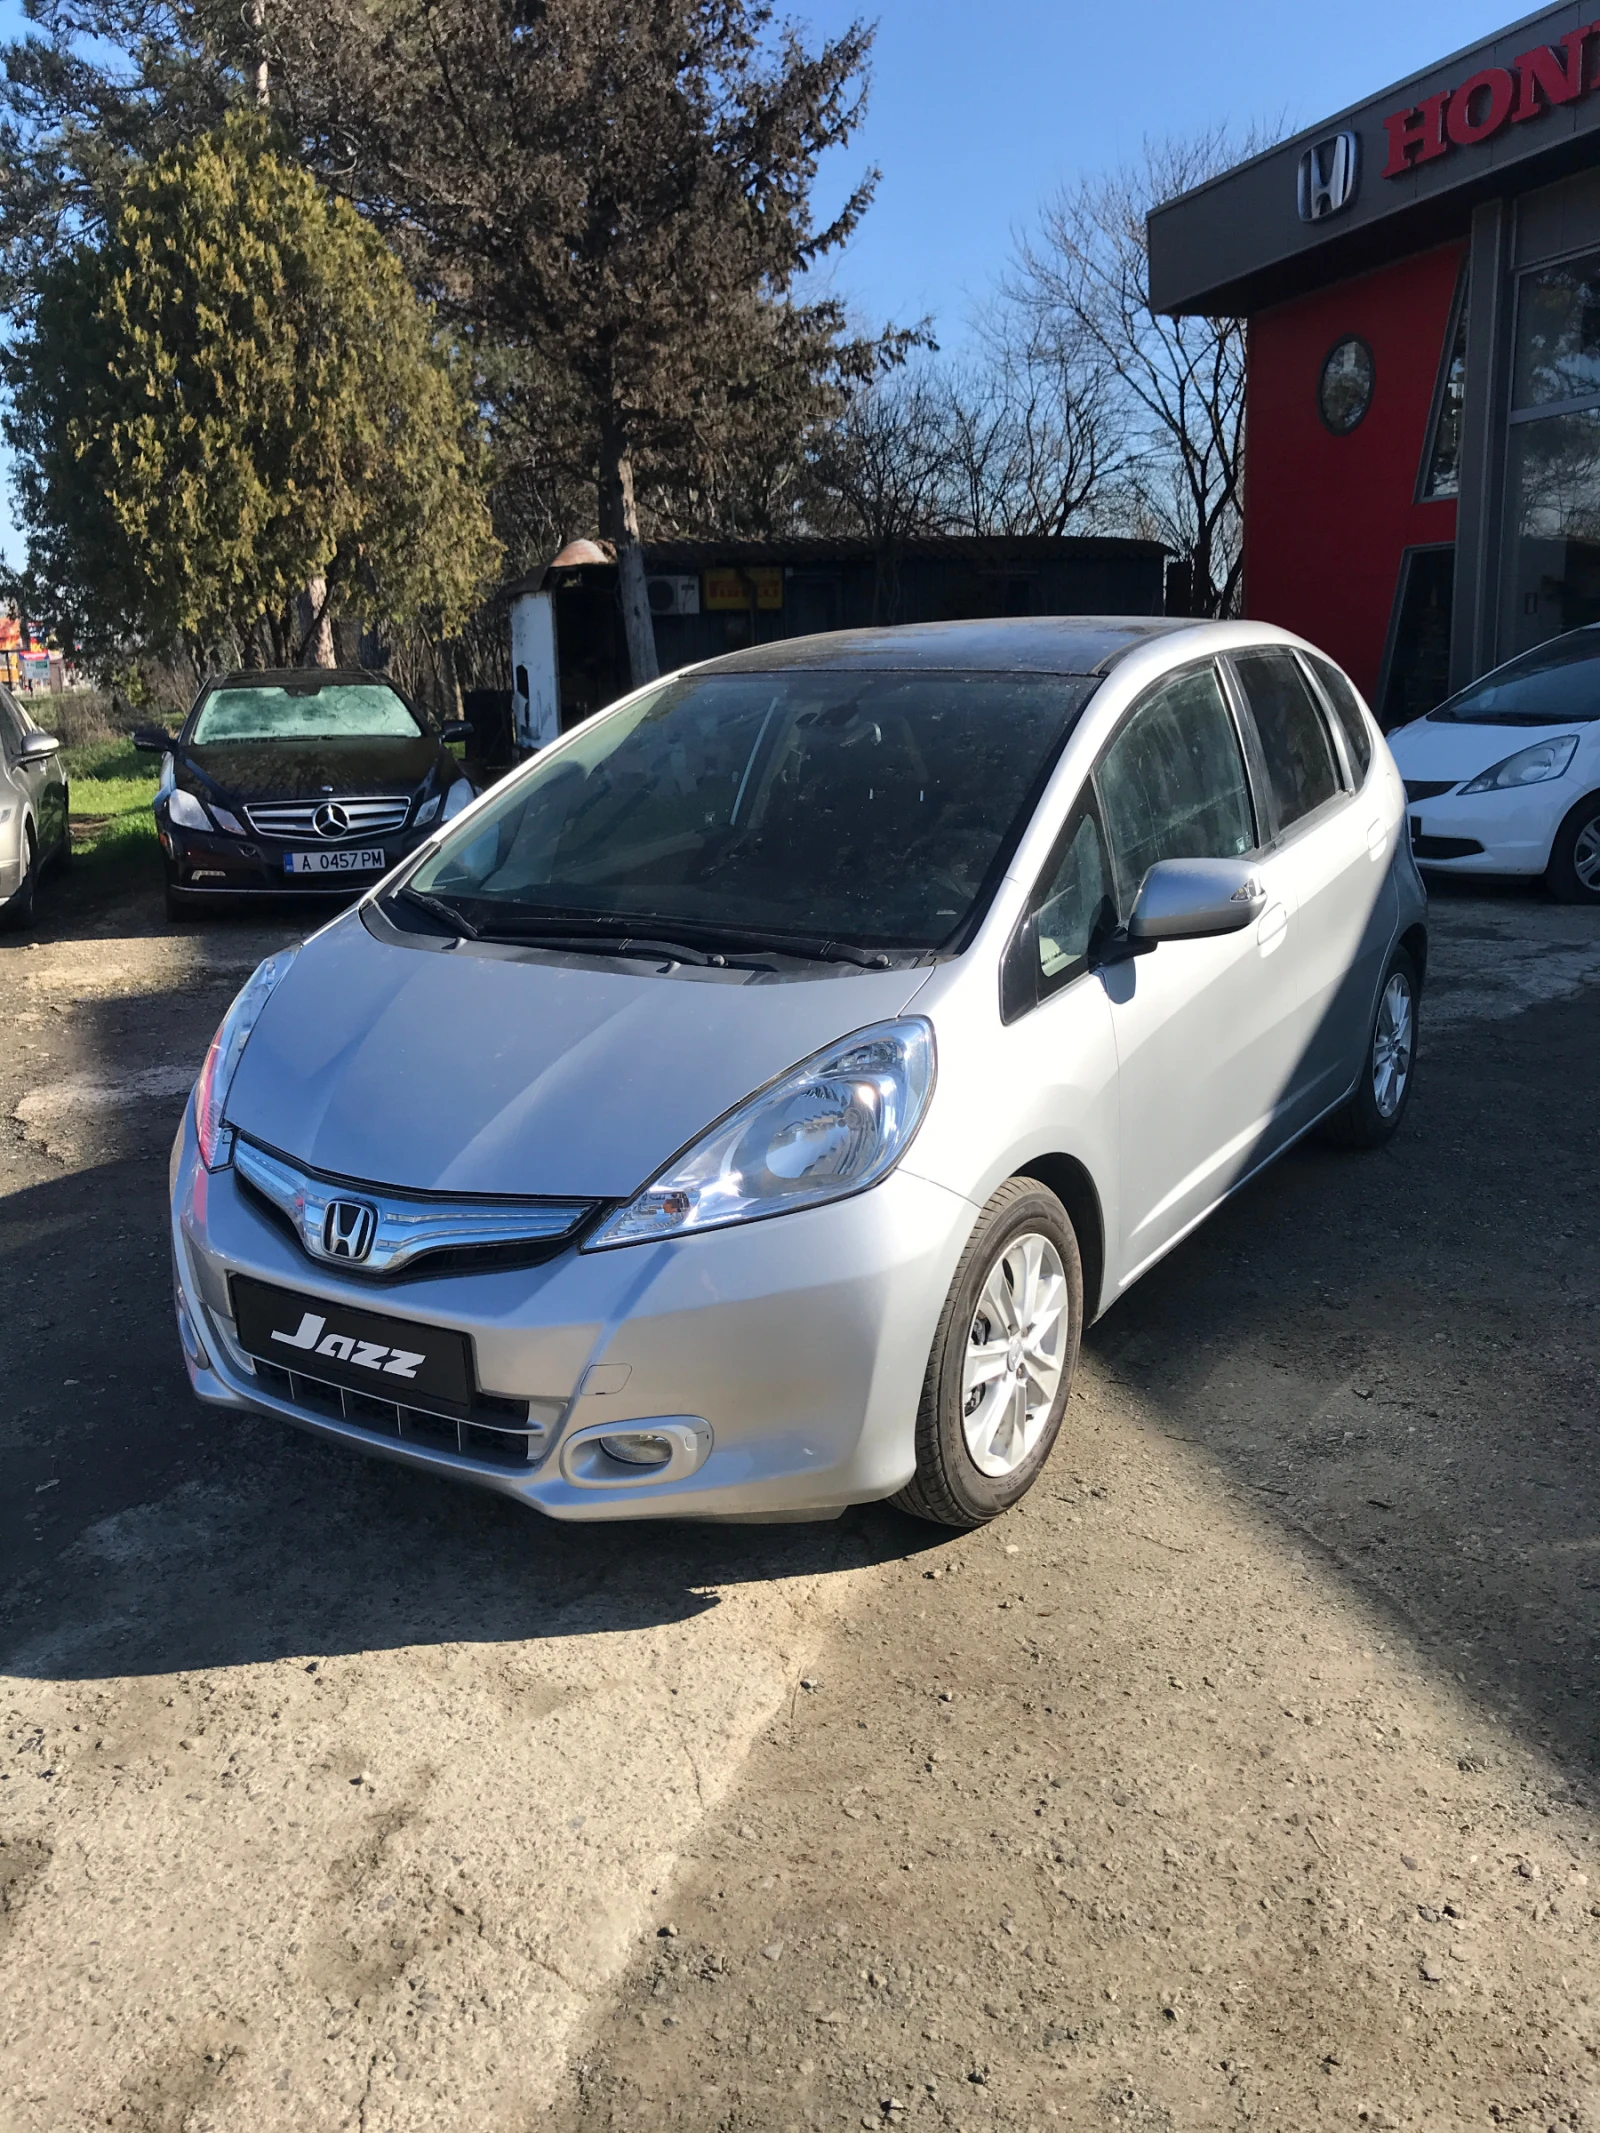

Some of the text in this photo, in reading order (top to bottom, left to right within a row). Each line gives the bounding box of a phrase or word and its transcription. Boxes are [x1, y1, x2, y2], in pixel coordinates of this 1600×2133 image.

[1381, 20, 1600, 179] HON
[302, 851, 382, 870] A 0457 PM
